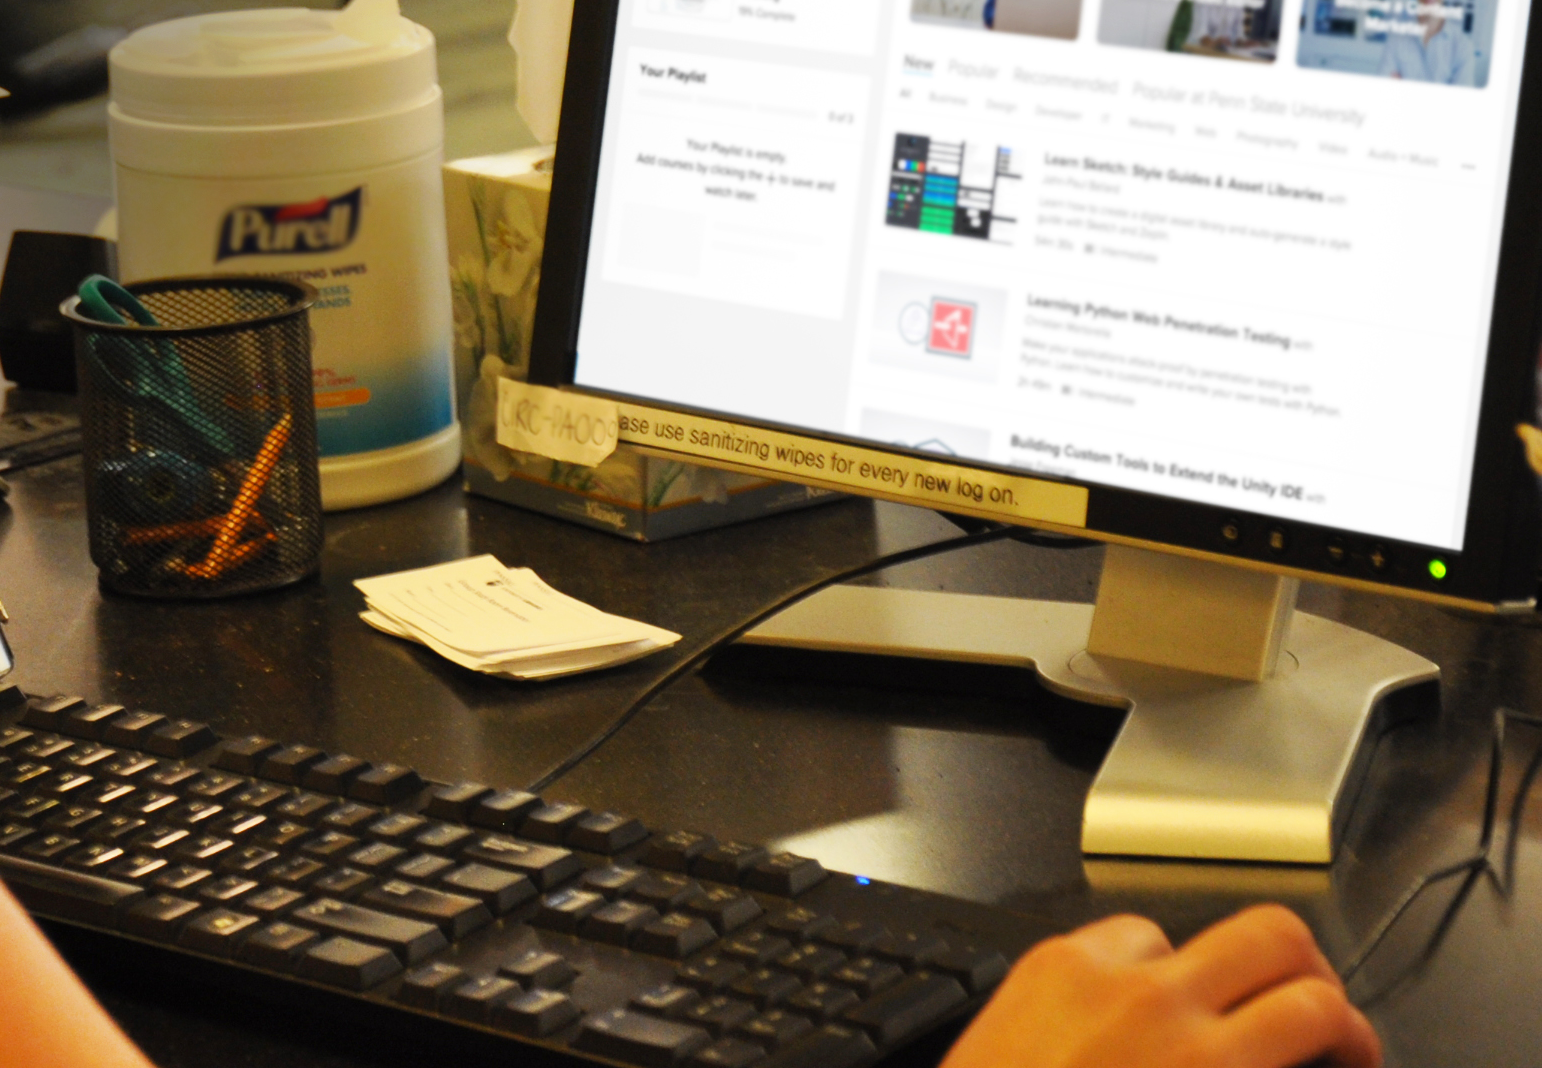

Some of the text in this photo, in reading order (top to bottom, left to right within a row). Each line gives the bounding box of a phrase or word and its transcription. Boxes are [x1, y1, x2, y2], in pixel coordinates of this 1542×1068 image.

[903, 53, 935, 71] New
[947, 58, 1000, 80] Popular
[640, 64, 707, 84] Your Playlist
[1012, 65, 1120, 96] Recommended
[899, 87, 912, 99] All
[985, 97, 1018, 114] Design
[1034, 103, 1084, 121] Developer
[1131, 80, 1367, 130] Popular at Penn State University
[1128, 116, 1176, 136] Marketing
[687, 137, 708, 152] Your
[710, 140, 743, 157] Playlist
[745, 149, 753, 159] is
[1235, 129, 1299, 150] Photography
[1317, 140, 1348, 156] Video
[636, 152, 656, 166] Add
[657, 157, 694, 171] courses
[696, 161, 708, 176] by
[710, 164, 746, 182] clicking
[748, 168, 764, 182] the
[779, 173, 789, 185] to
[791, 177, 814, 189] save
[816, 180, 836, 193] and
[1044, 150, 1348, 205] Learn Sketch: Style Guides & Asset Libraries with
[704, 186, 733, 197] watch
[228, 205, 353, 252] Purell
[331, 263, 367, 277] WIPES
[1027, 293, 1081, 317] Learning
[1084, 302, 1128, 320] Python
[1132, 309, 1161, 327] Web
[1164, 314, 1239, 339] Penetration
[1243, 326, 1291, 351] Testing
[1293, 339, 1314, 351] with
[618, 413, 1020, 507] ase use sanitizing wipes for every new log on.
[1010, 433, 1061, 458] Building
[1064, 443, 1112, 464] Custom
[1116, 452, 1150, 471] Tools
[1152, 460, 1166, 474] to
[1168, 462, 1214, 484] Extend
[1217, 473, 1239, 488] the
[1241, 476, 1277, 498] Unity
[1280, 483, 1304, 501] IDE
